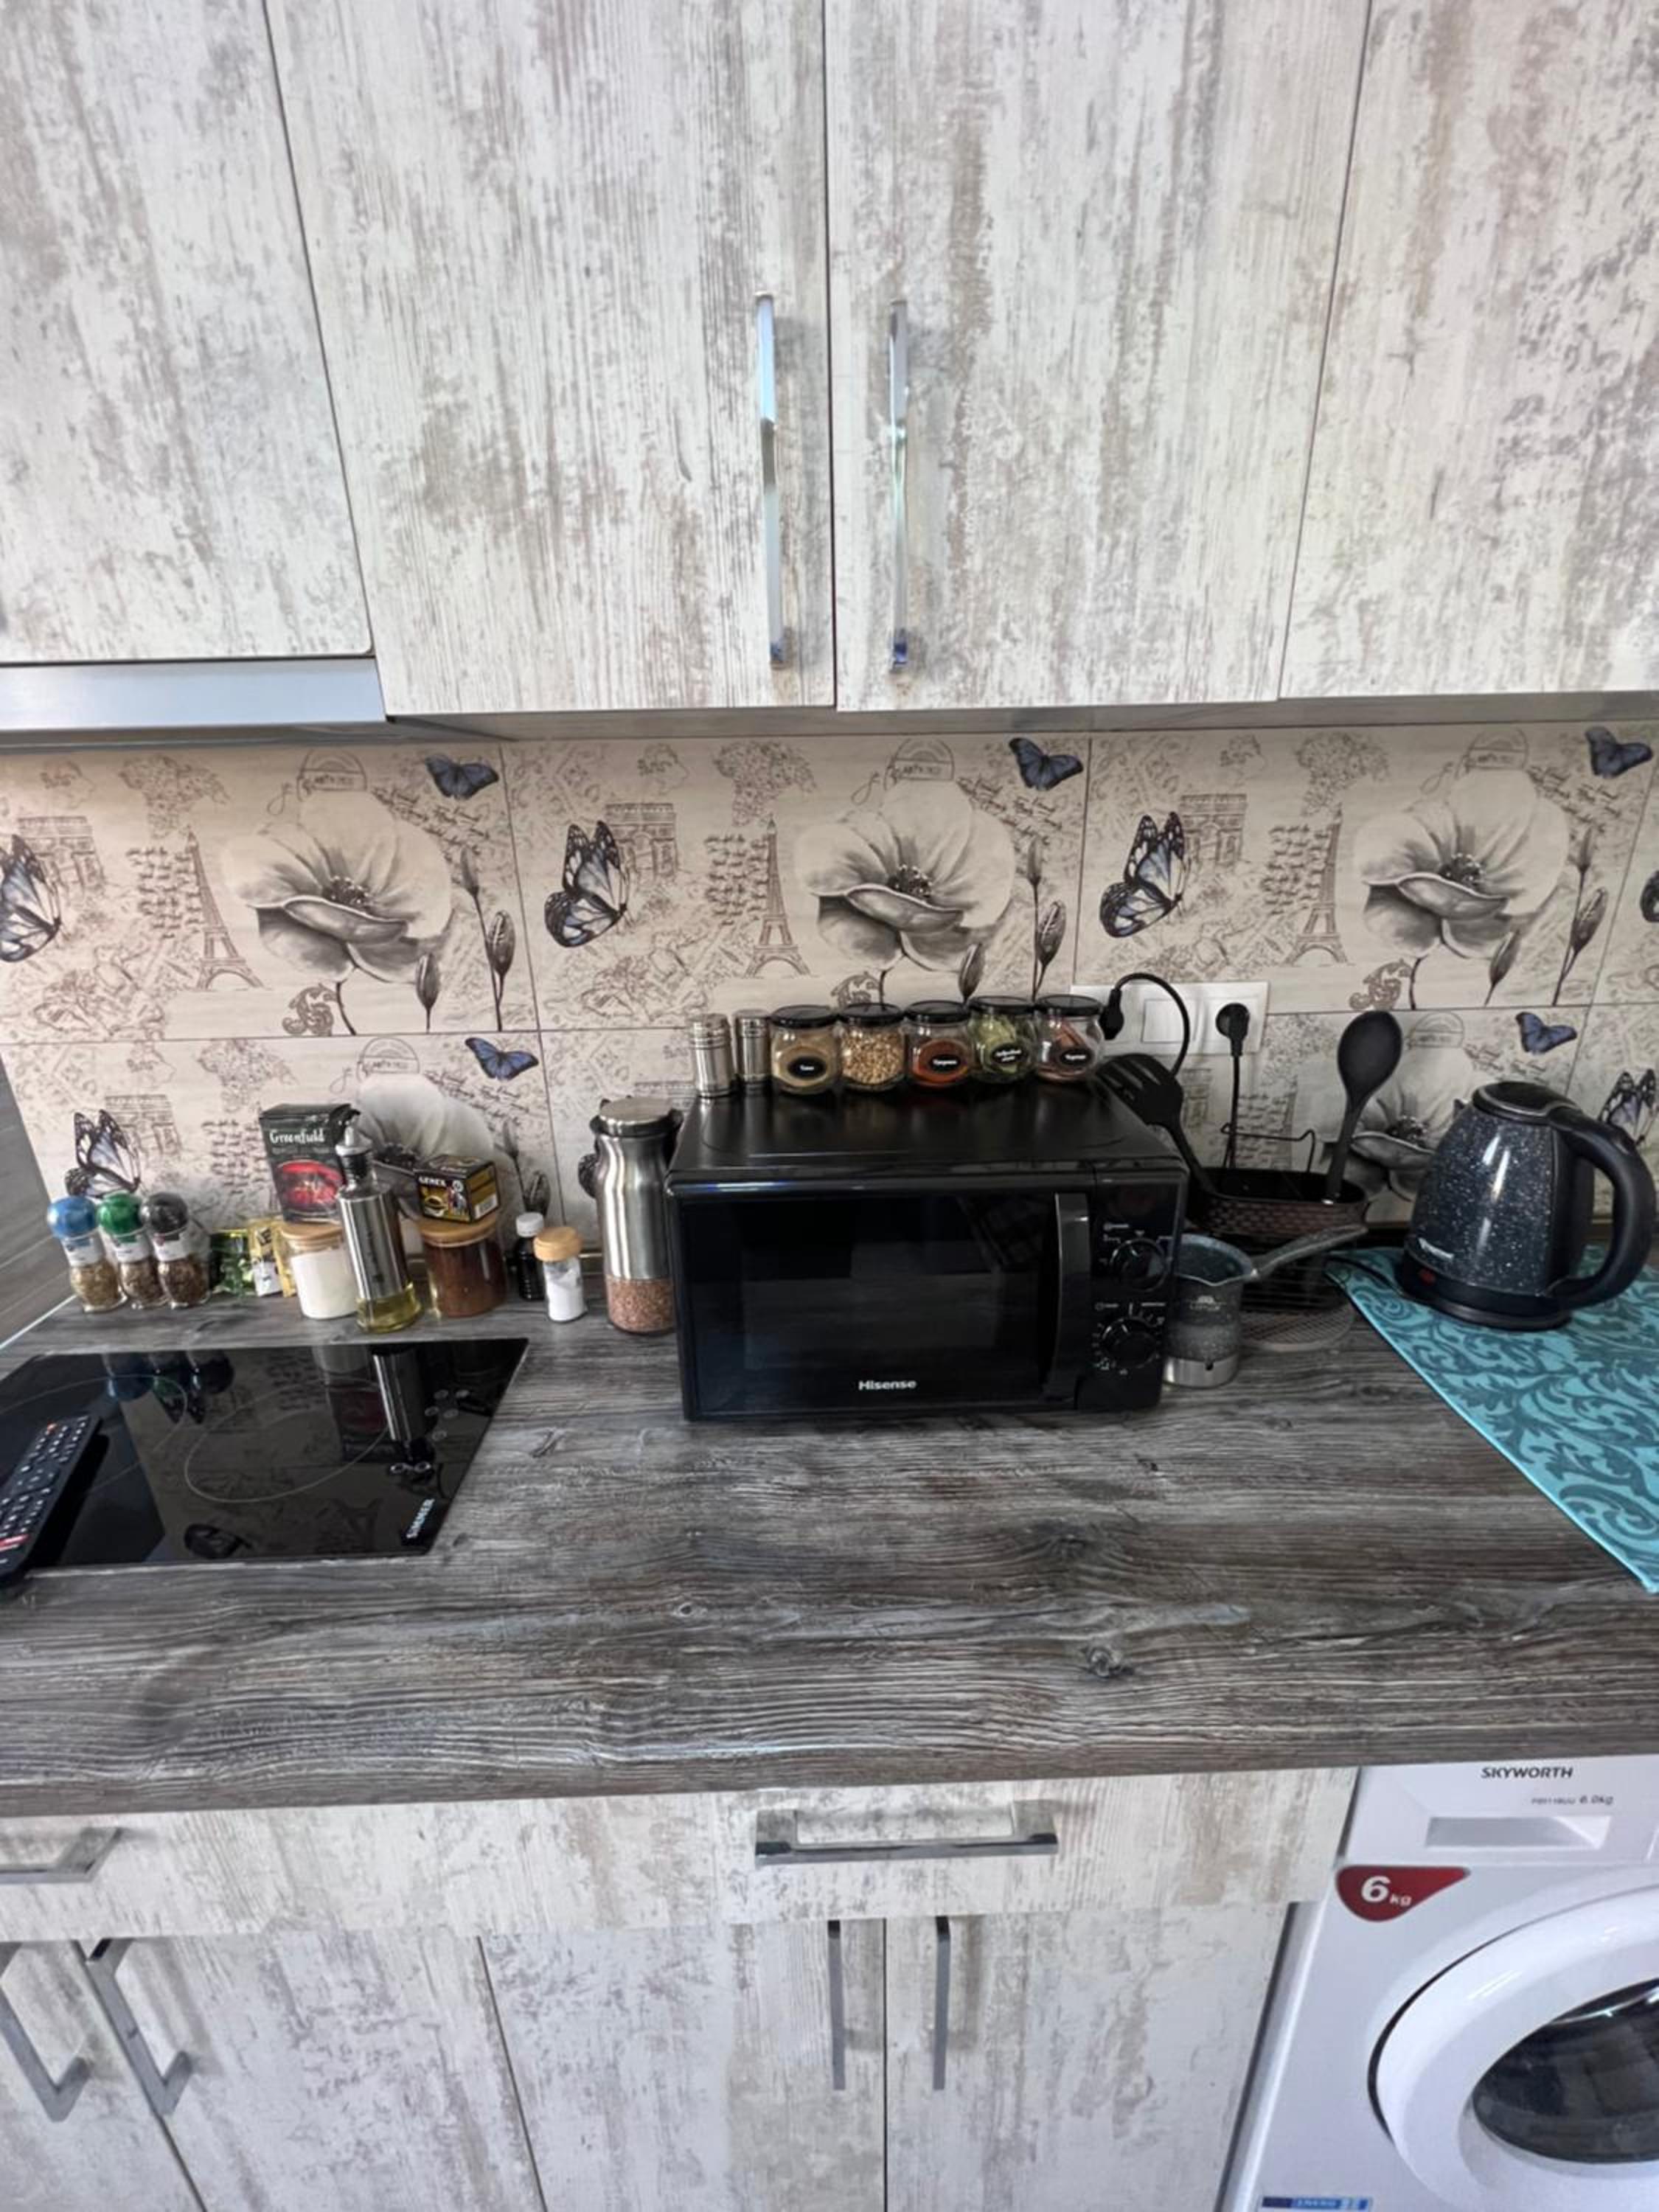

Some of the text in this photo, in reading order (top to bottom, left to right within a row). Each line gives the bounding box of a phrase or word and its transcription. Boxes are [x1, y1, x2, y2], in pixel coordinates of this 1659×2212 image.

[269, 1128, 325, 1144] Greenfield
[858, 1380, 917, 1391] Hisense
[1481, 1767, 1573, 1778] SKYWORTH
[1361, 1875, 1413, 1907] 6 kg
